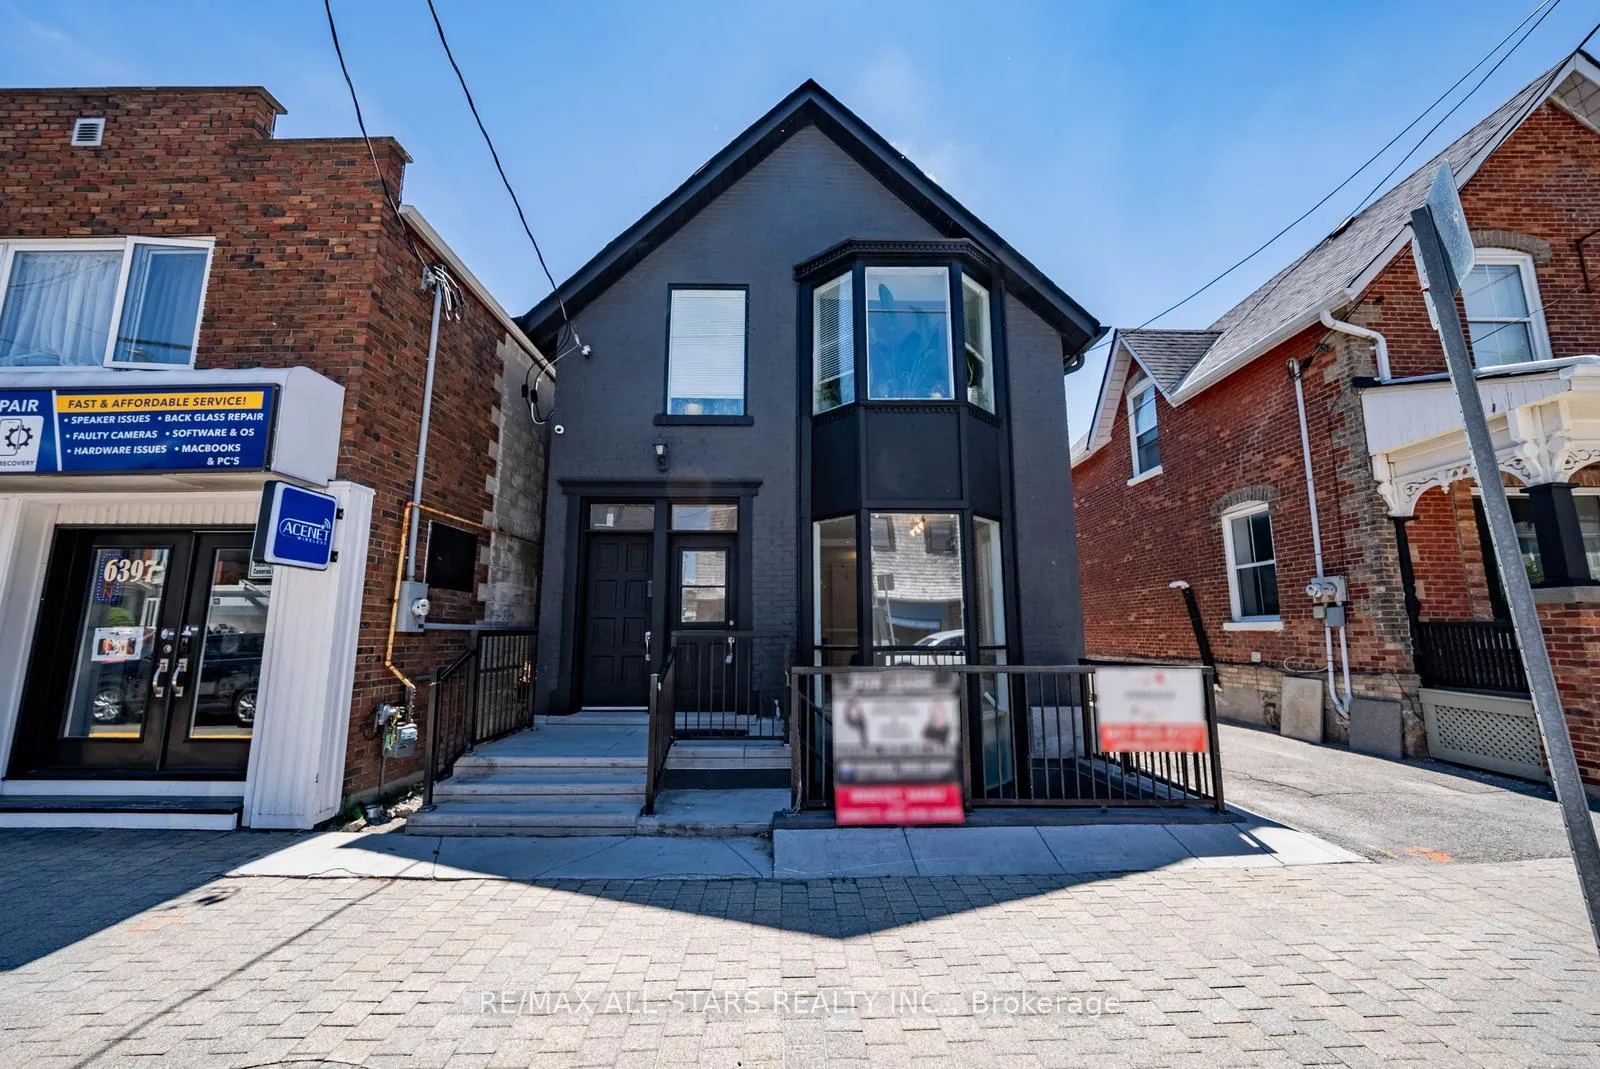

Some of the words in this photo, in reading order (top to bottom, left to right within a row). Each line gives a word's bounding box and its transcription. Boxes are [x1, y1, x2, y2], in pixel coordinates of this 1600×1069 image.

[0, 399, 39, 412] PAIR
[68, 399, 97, 408] FAST
[100, 399, 108, 408] &
[112, 397, 190, 408] AFFORDABLE
[193, 396, 247, 407] SERVICE!
[71, 415, 115, 424] SPEAKER
[118, 415, 151, 423] ISSUES
[164, 413, 192, 422] BACK
[194, 413, 225, 421] GLASS
[228, 412, 264, 421] REPAIR
[73, 431, 109, 440] FAULTY
[111, 430, 158, 439] CAMERAS
[172, 428, 228, 438] SOFTWARE
[229, 428, 237, 437] &
[240, 428, 255, 436] OS
[74, 446, 131, 455] HARDWARE
[133, 445, 167, 454] ISSUES
[181, 443, 241, 453] MACBOOKS
[207, 457, 215, 466] &
[217, 456, 240, 465] PC'S
[283, 521, 330, 542] ACENET
[297, 536, 327, 546] WIRELESS
[103, 559, 155, 583] 6397
